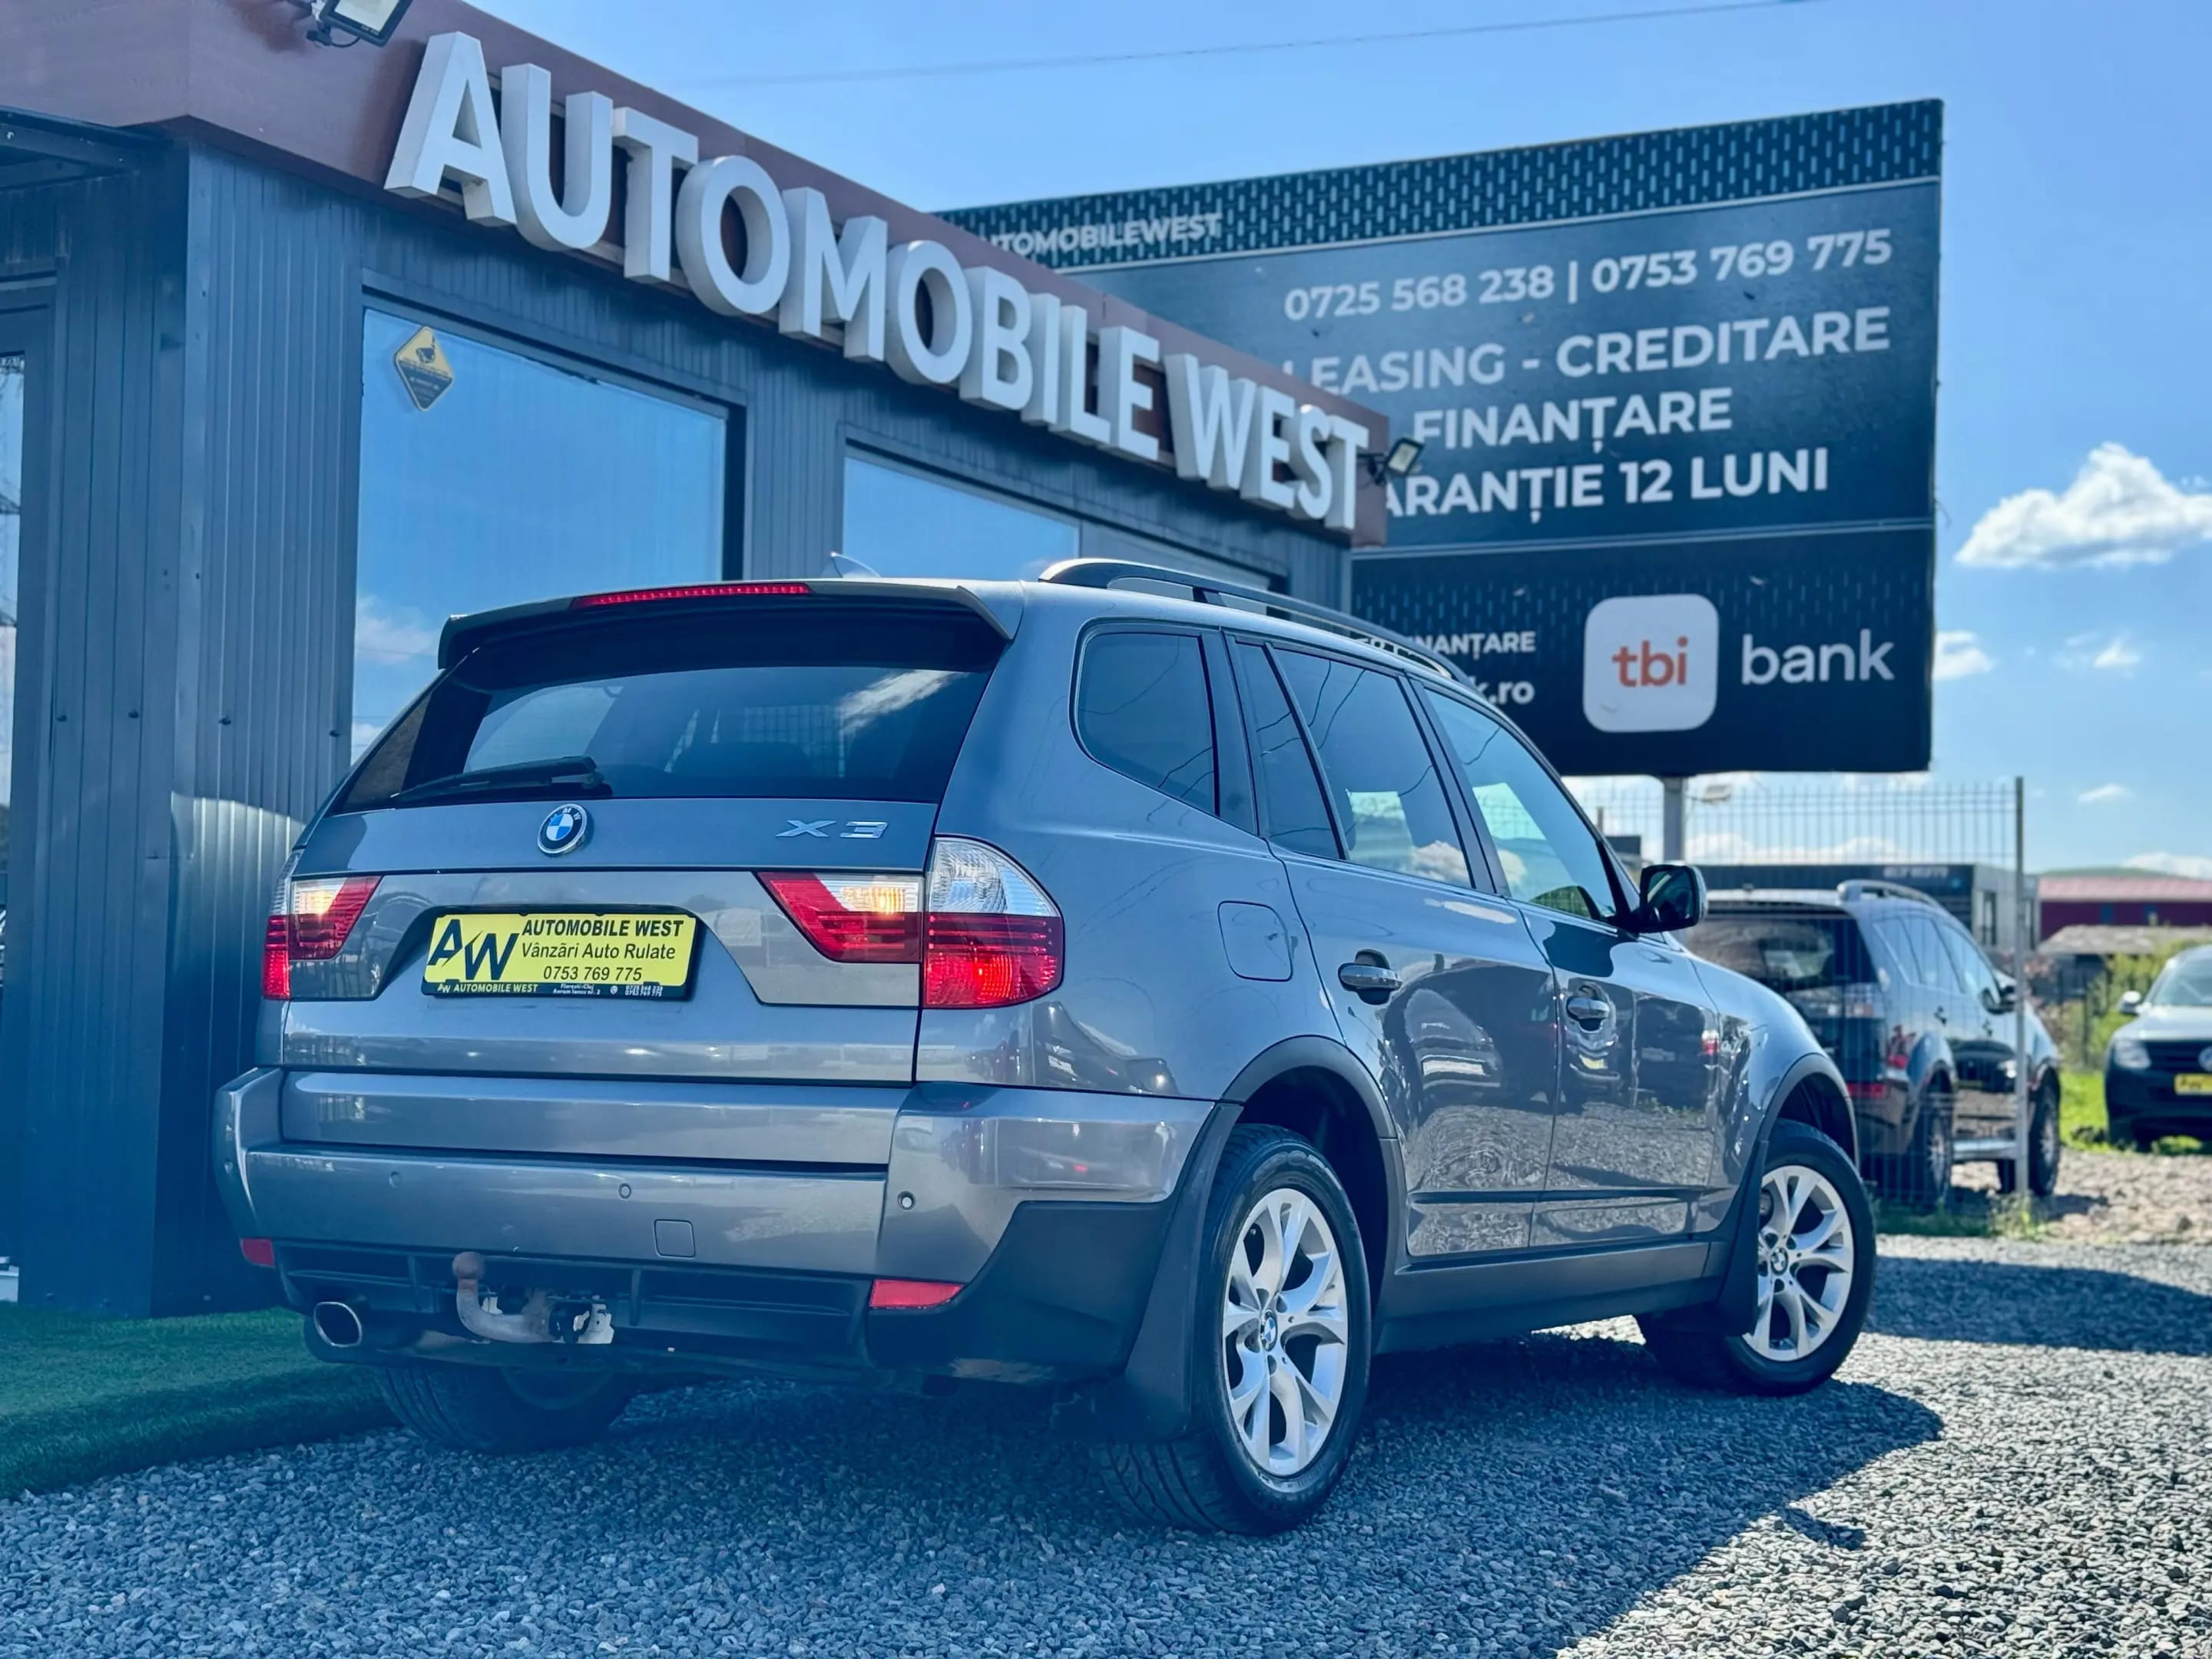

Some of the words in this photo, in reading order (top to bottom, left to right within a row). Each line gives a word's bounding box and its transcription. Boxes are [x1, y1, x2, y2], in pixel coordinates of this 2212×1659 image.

[384, 31, 1160, 462] AUTOMOBILE
[1164, 352, 1369, 531] WEST
[1284, 281, 1380, 320] 0725
[1391, 273, 1466, 312] 568
[1479, 264, 1555, 304] 238
[1591, 250, 1697, 293] 0753
[1710, 240, 1794, 282] 769
[1807, 229, 1892, 271] 775
[1556, 306, 1891, 378] CREDITARE
[1619, 459, 1673, 503] 12
[1690, 448, 1828, 499] LUNI
[1611, 636, 1688, 688] tbi
[1741, 628, 1895, 685] bank
[522, 919, 630, 937] AUTOMOBILE
[635, 920, 684, 937] WEST
[581, 943, 620, 959] Auto
[624, 943, 676, 959] Rulate
[453, 983, 511, 993] AUTOMOBILE
[512, 984, 538, 993] WEST
[543, 965, 578, 980] 0753
[583, 966, 611, 981] 769
[614, 967, 643, 982] 775
